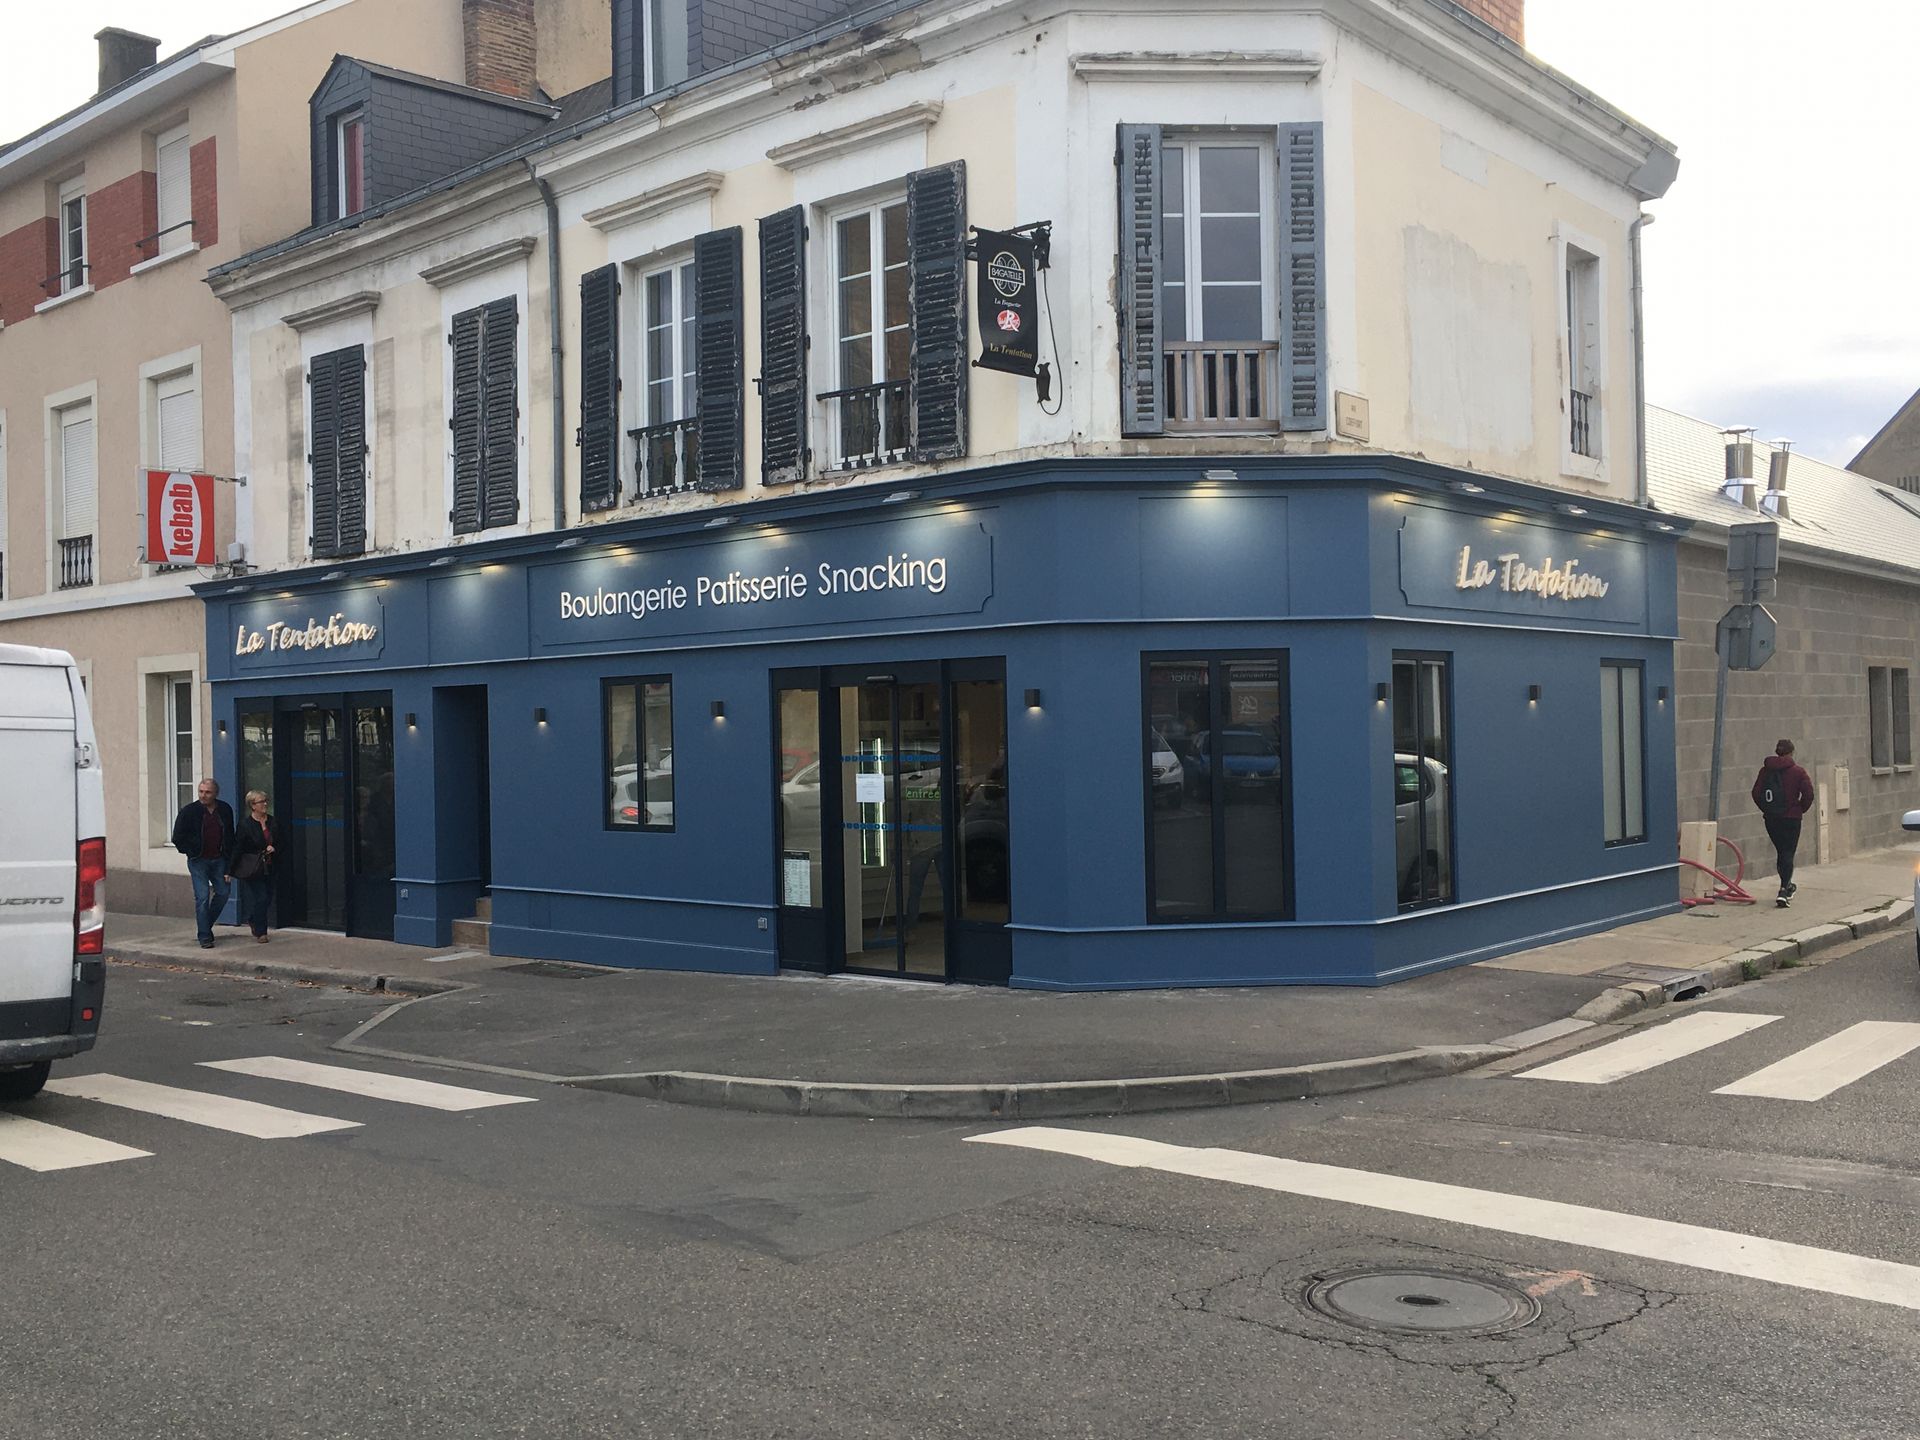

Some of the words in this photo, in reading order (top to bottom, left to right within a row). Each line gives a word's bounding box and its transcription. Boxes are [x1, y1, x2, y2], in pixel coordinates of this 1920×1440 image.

[992, 267, 1022, 281] BAGATELLE
[990, 343, 999, 352] La
[1001, 344, 1033, 359] Tentation
[169, 483, 193, 556] kebab
[560, 579, 687, 619] Boulangerie
[697, 566, 807, 606] Patisserie
[818, 553, 947, 594] Snacking
[1456, 545, 1496, 588] La
[1499, 553, 1609, 600] Tentation
[236, 625, 265, 655] La
[267, 613, 376, 651] Tentation
